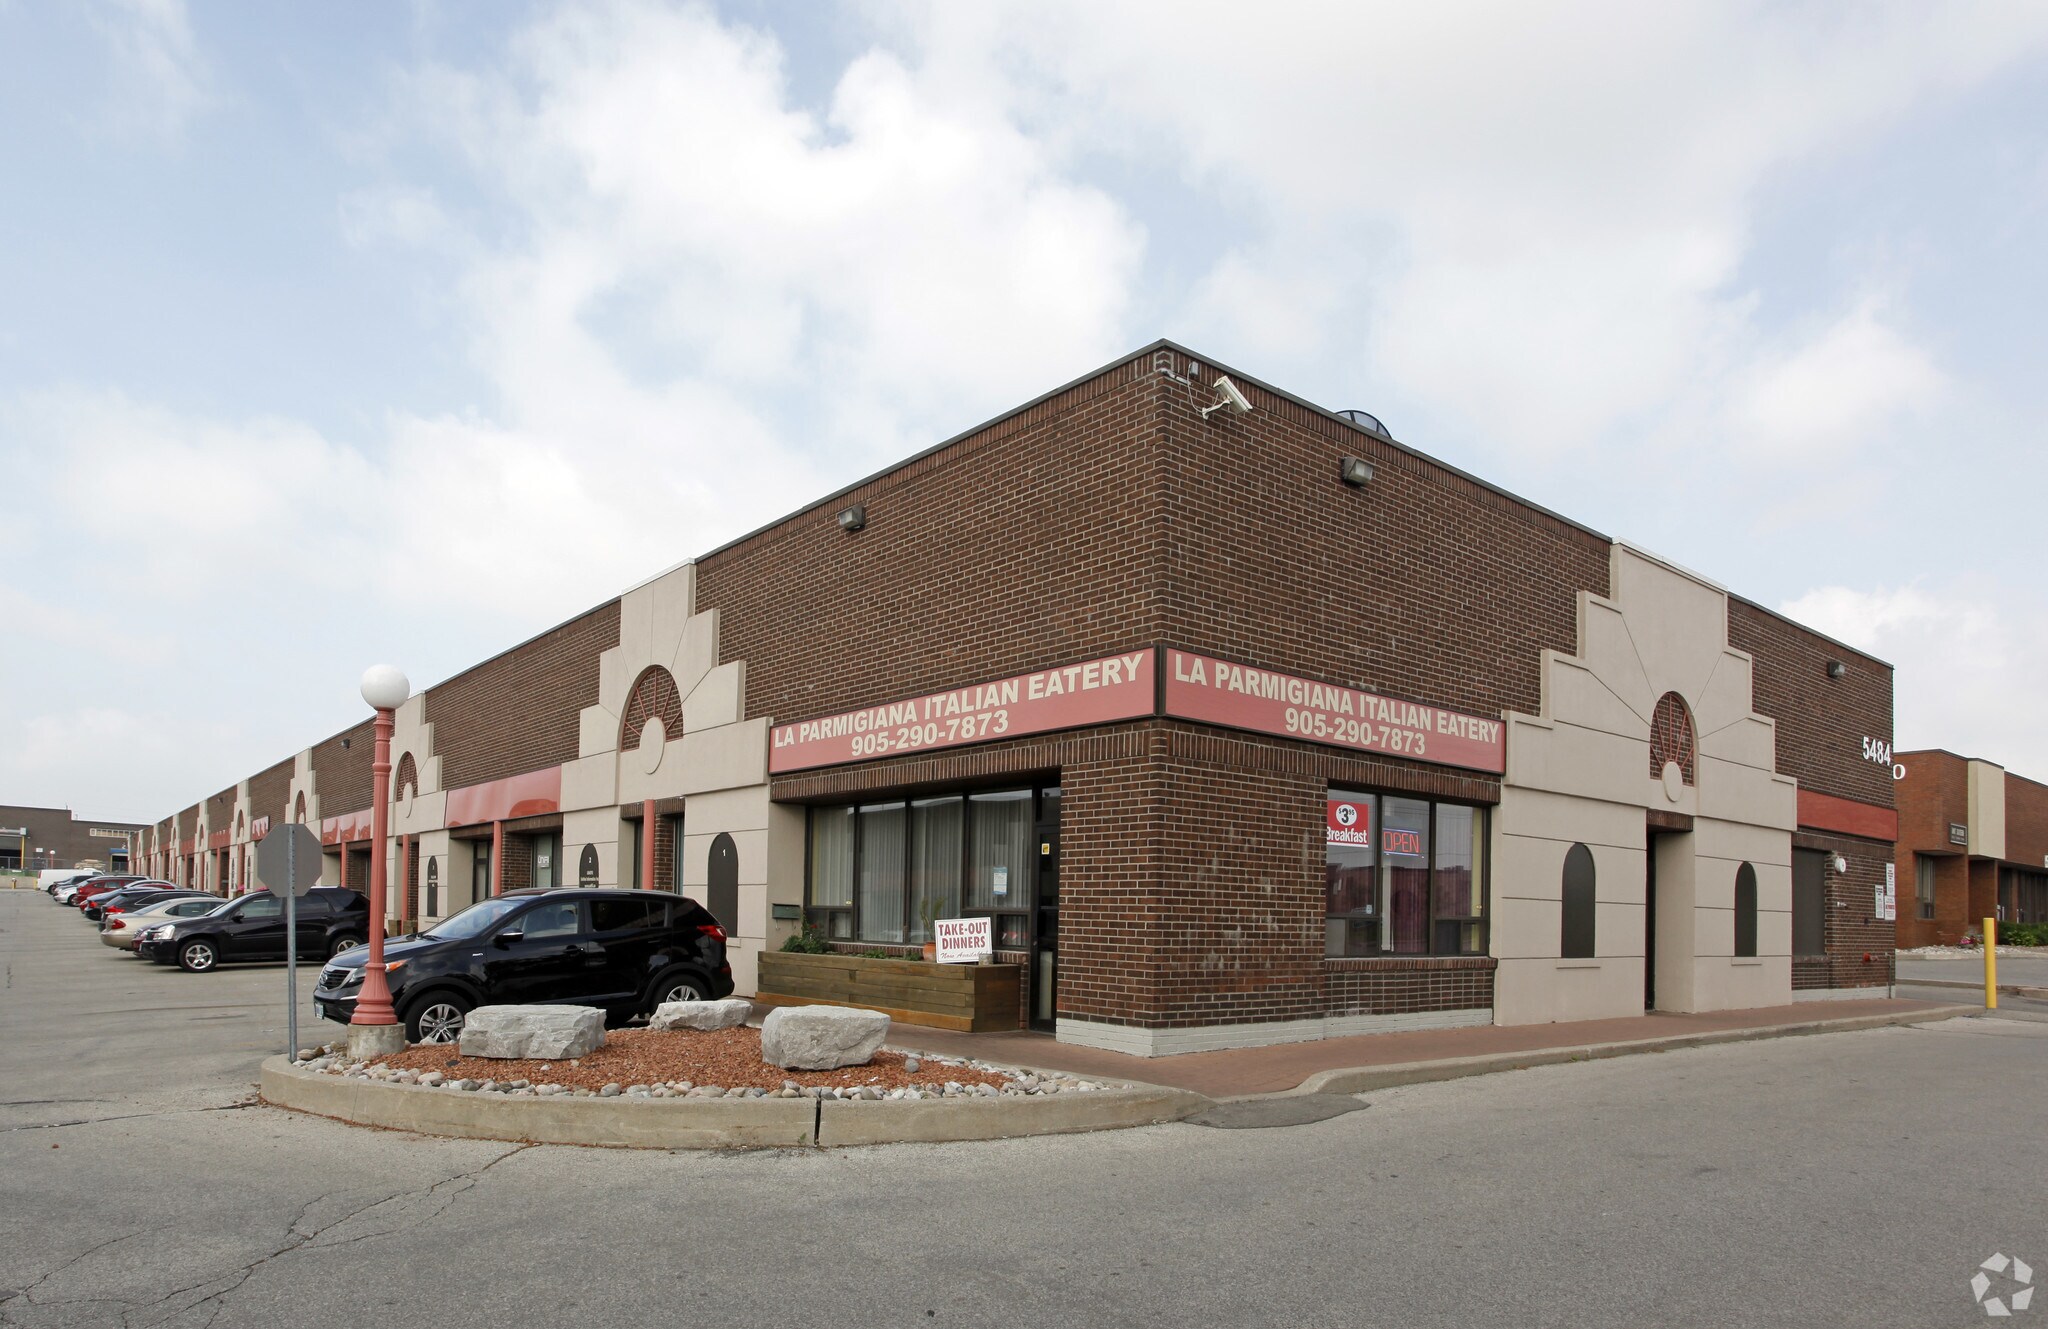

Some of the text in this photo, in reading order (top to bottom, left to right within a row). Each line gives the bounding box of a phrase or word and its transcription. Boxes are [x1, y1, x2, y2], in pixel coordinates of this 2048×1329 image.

[774, 652, 1144, 748] LA PARMIGIANA ITALIAN EATERY
[1175, 653, 1499, 744] LA PARMIGIANA ITALIAN EATERY
[851, 709, 1009, 757] 905-290-7873
[1285, 707, 1426, 755] 905-290-7873
[1863, 736, 1890, 766] 5484
[1327, 827, 1367, 843] Breakfast
[1383, 831, 1420, 853] OPEN
[938, 922, 987, 936] TAKE-OUT
[942, 936, 985, 949] DINNERS
